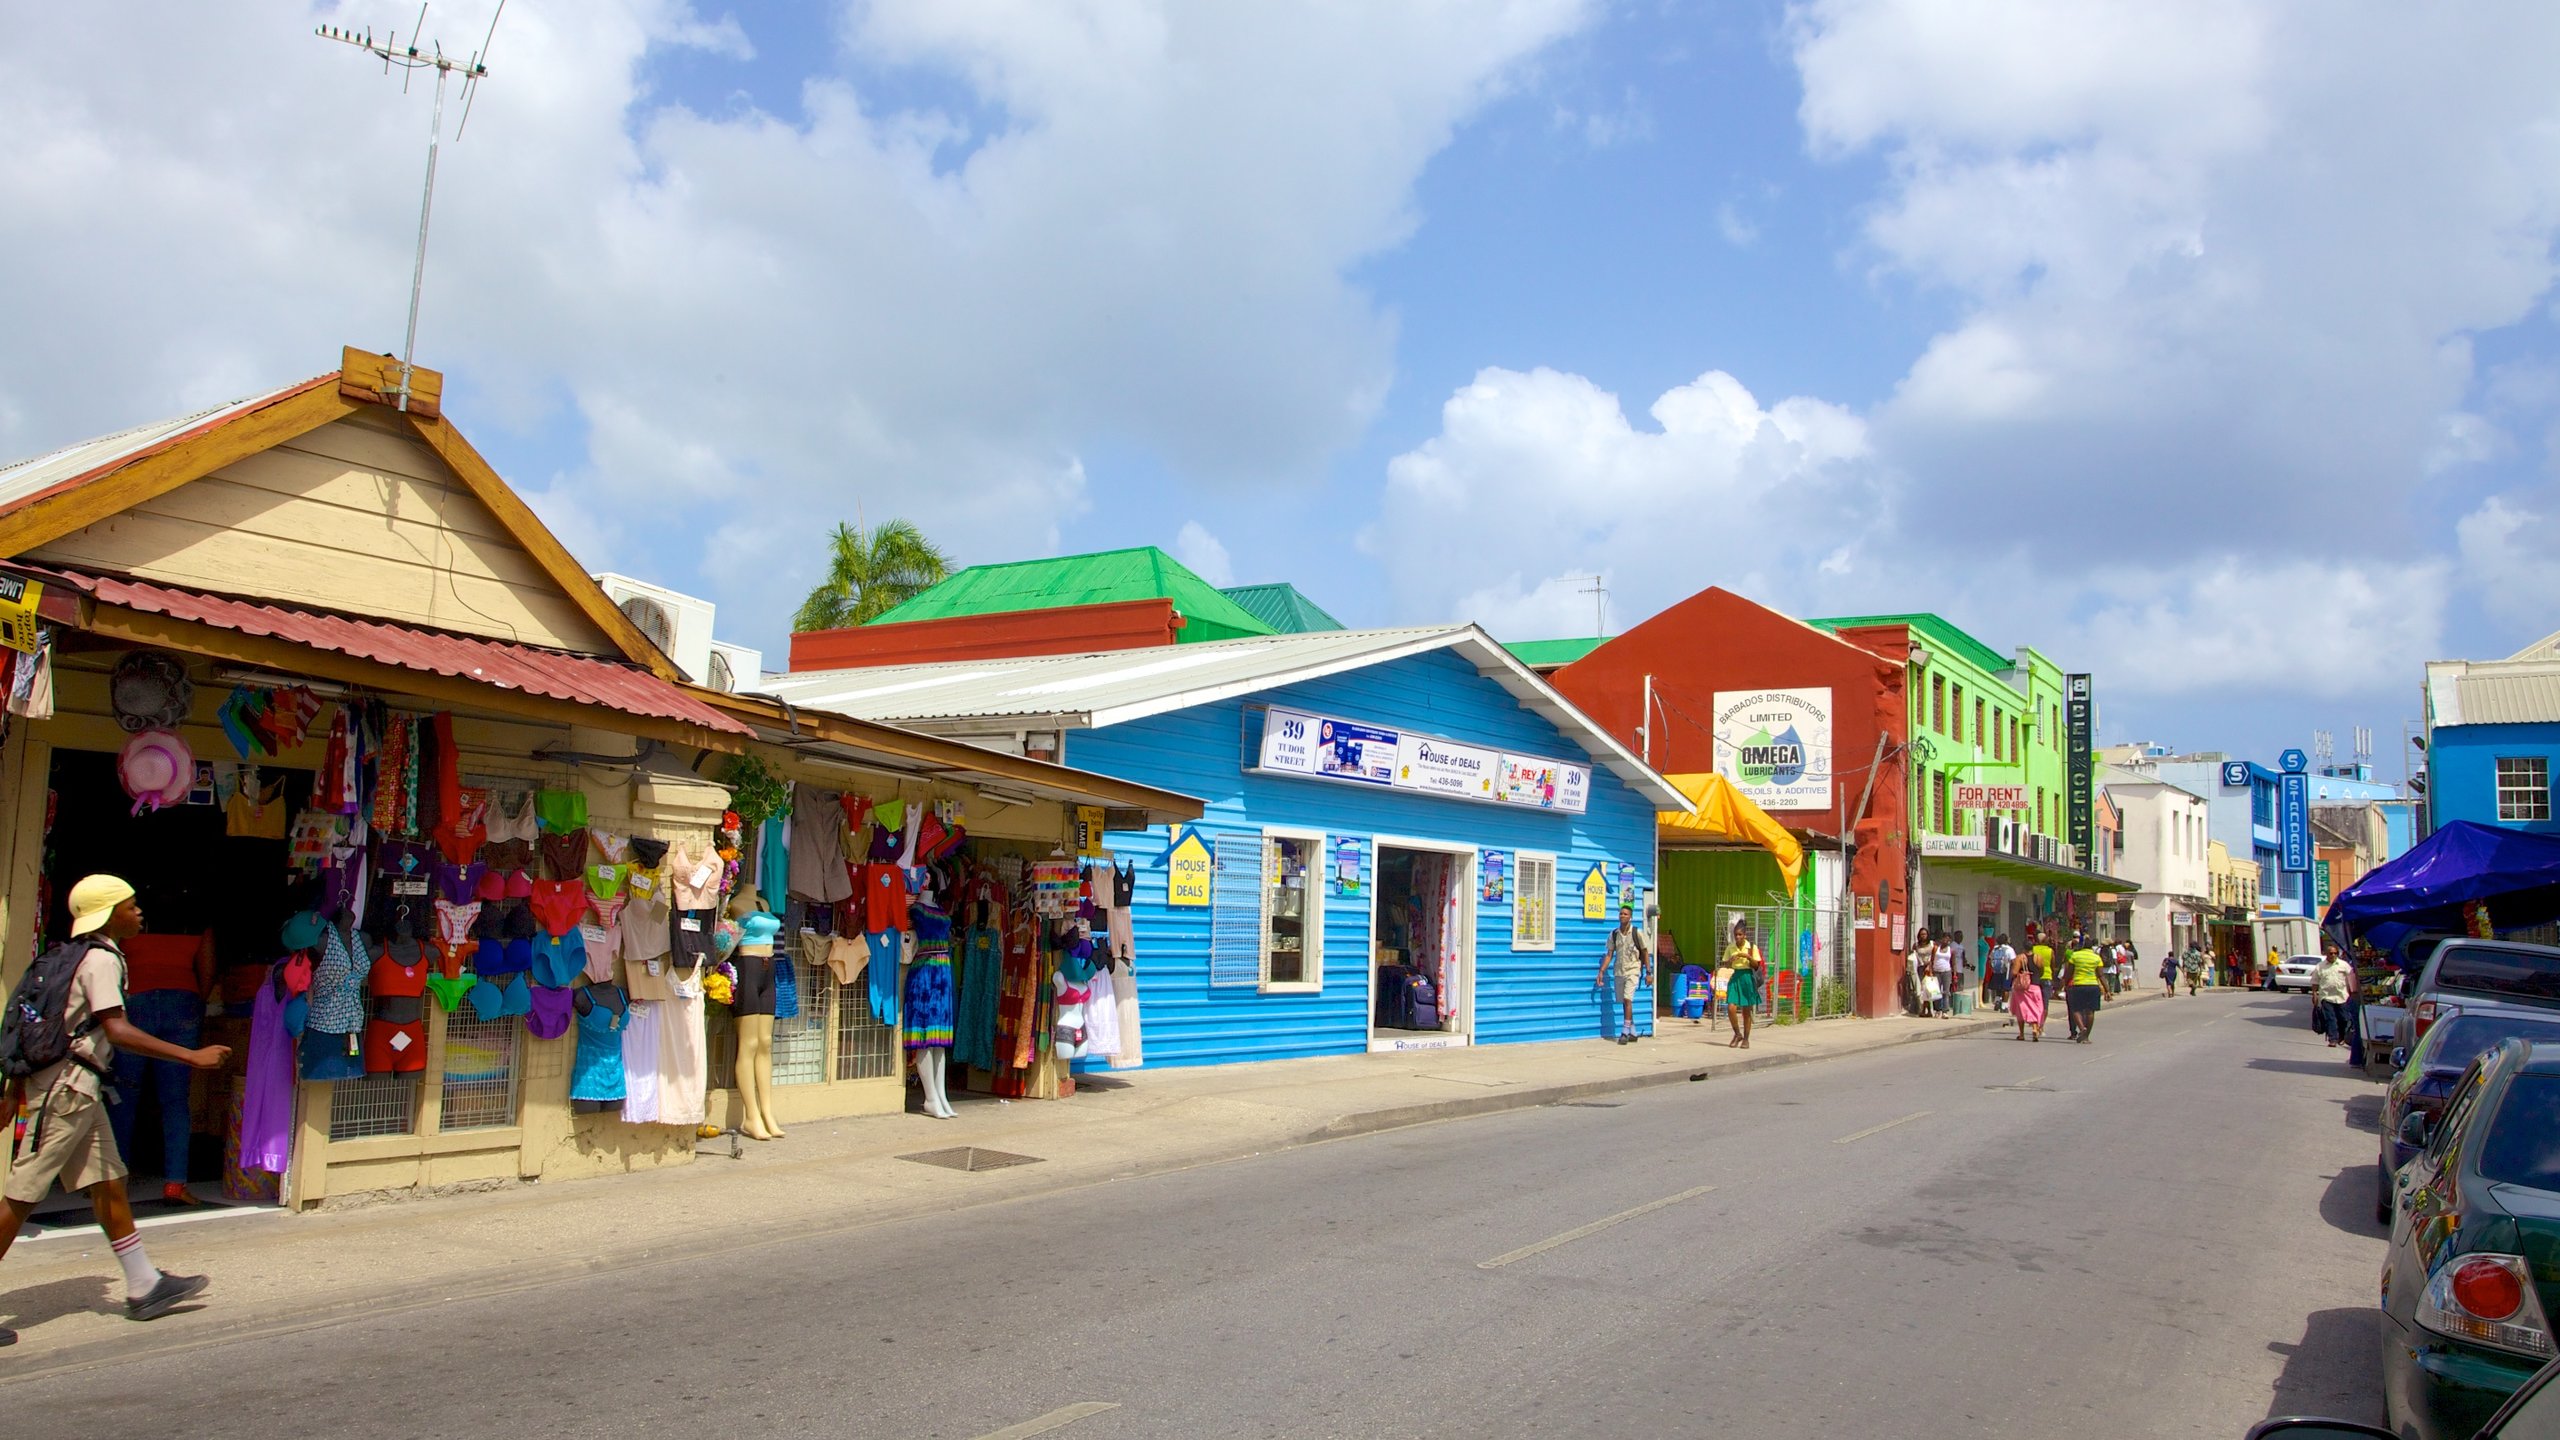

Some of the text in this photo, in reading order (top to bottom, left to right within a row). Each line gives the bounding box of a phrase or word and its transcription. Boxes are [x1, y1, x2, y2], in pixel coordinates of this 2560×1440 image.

[0, 577, 24, 600] LIME
[16, 614, 26, 647] here.
[24, 608, 34, 650] TopUp
[1719, 694, 1826, 725] BARBADOS DISTRIBUTORS
[1750, 712, 1792, 722] LIMITED
[1282, 720, 1304, 740] 39
[2072, 704, 2086, 753] BED
[1278, 743, 1305, 754] TUDOR
[1274, 754, 1306, 766] STREET
[1419, 750, 1448, 765] HOUSE
[1450, 756, 1458, 765] of
[1459, 758, 1481, 770] DEALS
[1742, 746, 1800, 766] OMEGA
[2287, 754, 2298, 768] S
[1521, 769, 1537, 780] REY
[1744, 766, 1796, 776] LUBRICANTS
[2230, 766, 2242, 781] S
[1567, 770, 1581, 786] 39
[1564, 788, 1581, 798] TUDOR
[1959, 788, 2022, 800] FOR RENT
[1561, 798, 1580, 807] STREET
[2072, 773, 2087, 870] CENTER
[2288, 779, 2301, 866] STANDARD
[1926, 840, 1981, 850] GATEWAY MALL
[1176, 859, 1206, 872] HOUSE
[1176, 885, 1203, 898] DEALS
[1588, 885, 1603, 895] HOUSE
[1588, 904, 1602, 913] DEALS
